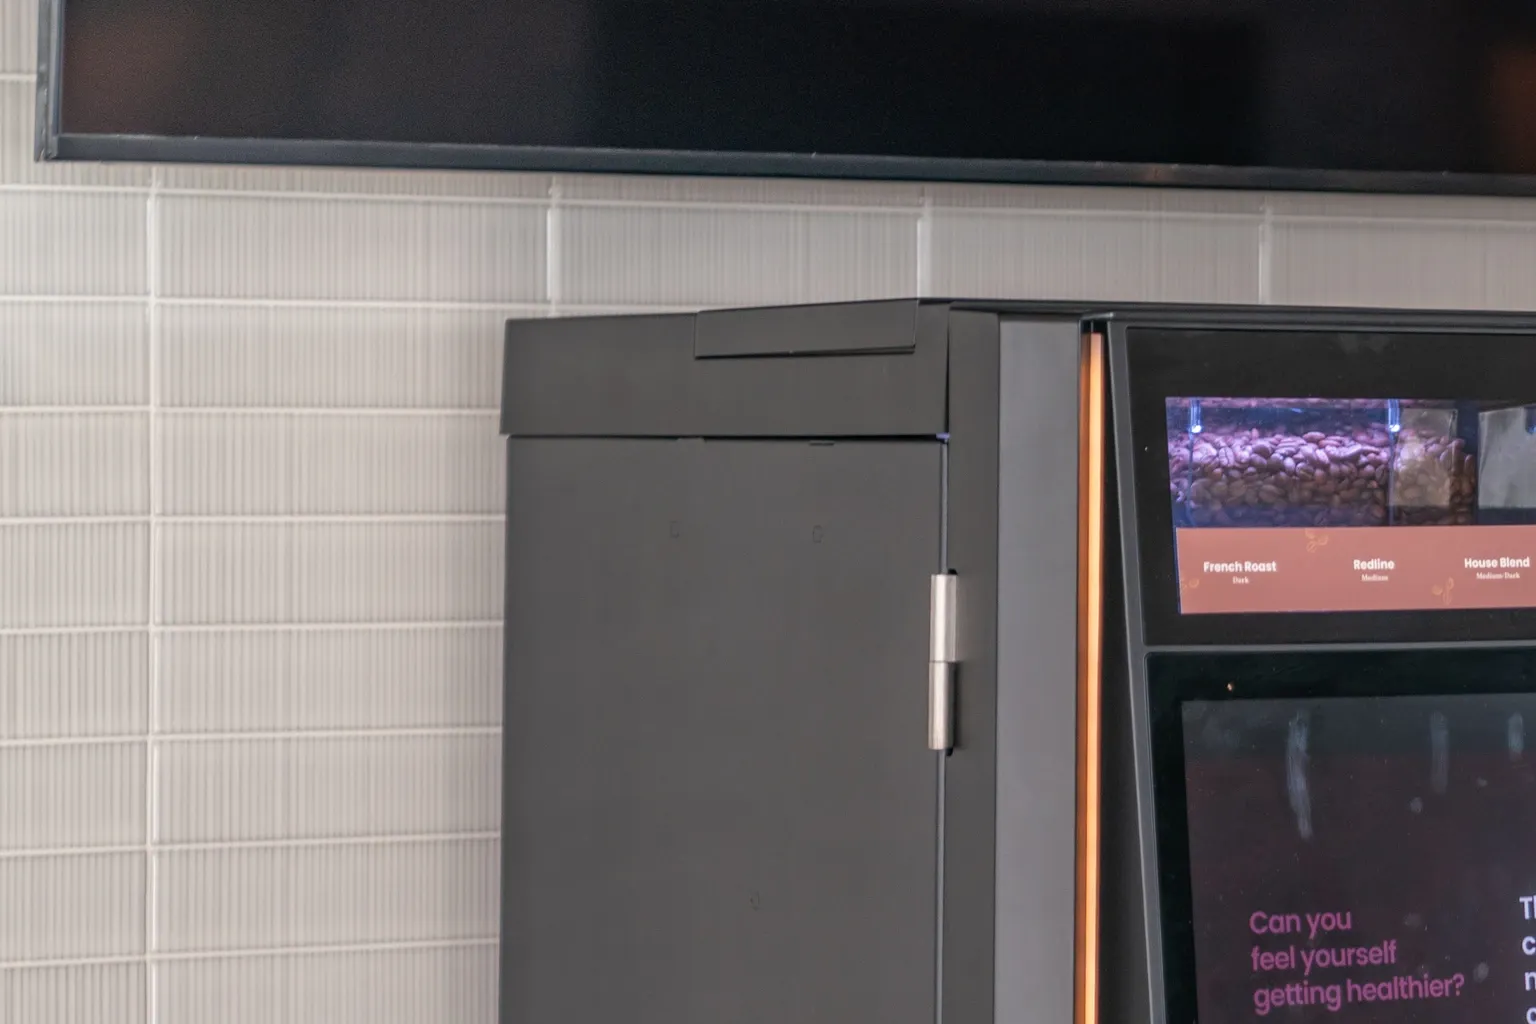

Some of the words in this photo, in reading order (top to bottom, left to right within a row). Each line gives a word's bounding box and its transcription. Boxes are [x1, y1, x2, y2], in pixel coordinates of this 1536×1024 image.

[1203, 561, 1243, 573] French
[1244, 560, 1277, 573] Roast
[1353, 558, 1395, 571] Redline
[1464, 557, 1498, 569] House
[1500, 556, 1530, 568] Blend
[1232, 576, 1249, 584] Dark
[1361, 574, 1389, 582] Medium
[1250, 910, 1300, 934] Can
[1305, 911, 1352, 939] you
[1251, 945, 1295, 971] feel
[1301, 939, 1397, 976] yourself
[1254, 980, 1342, 1016] getting
[1347, 973, 1465, 1003] healthier?
